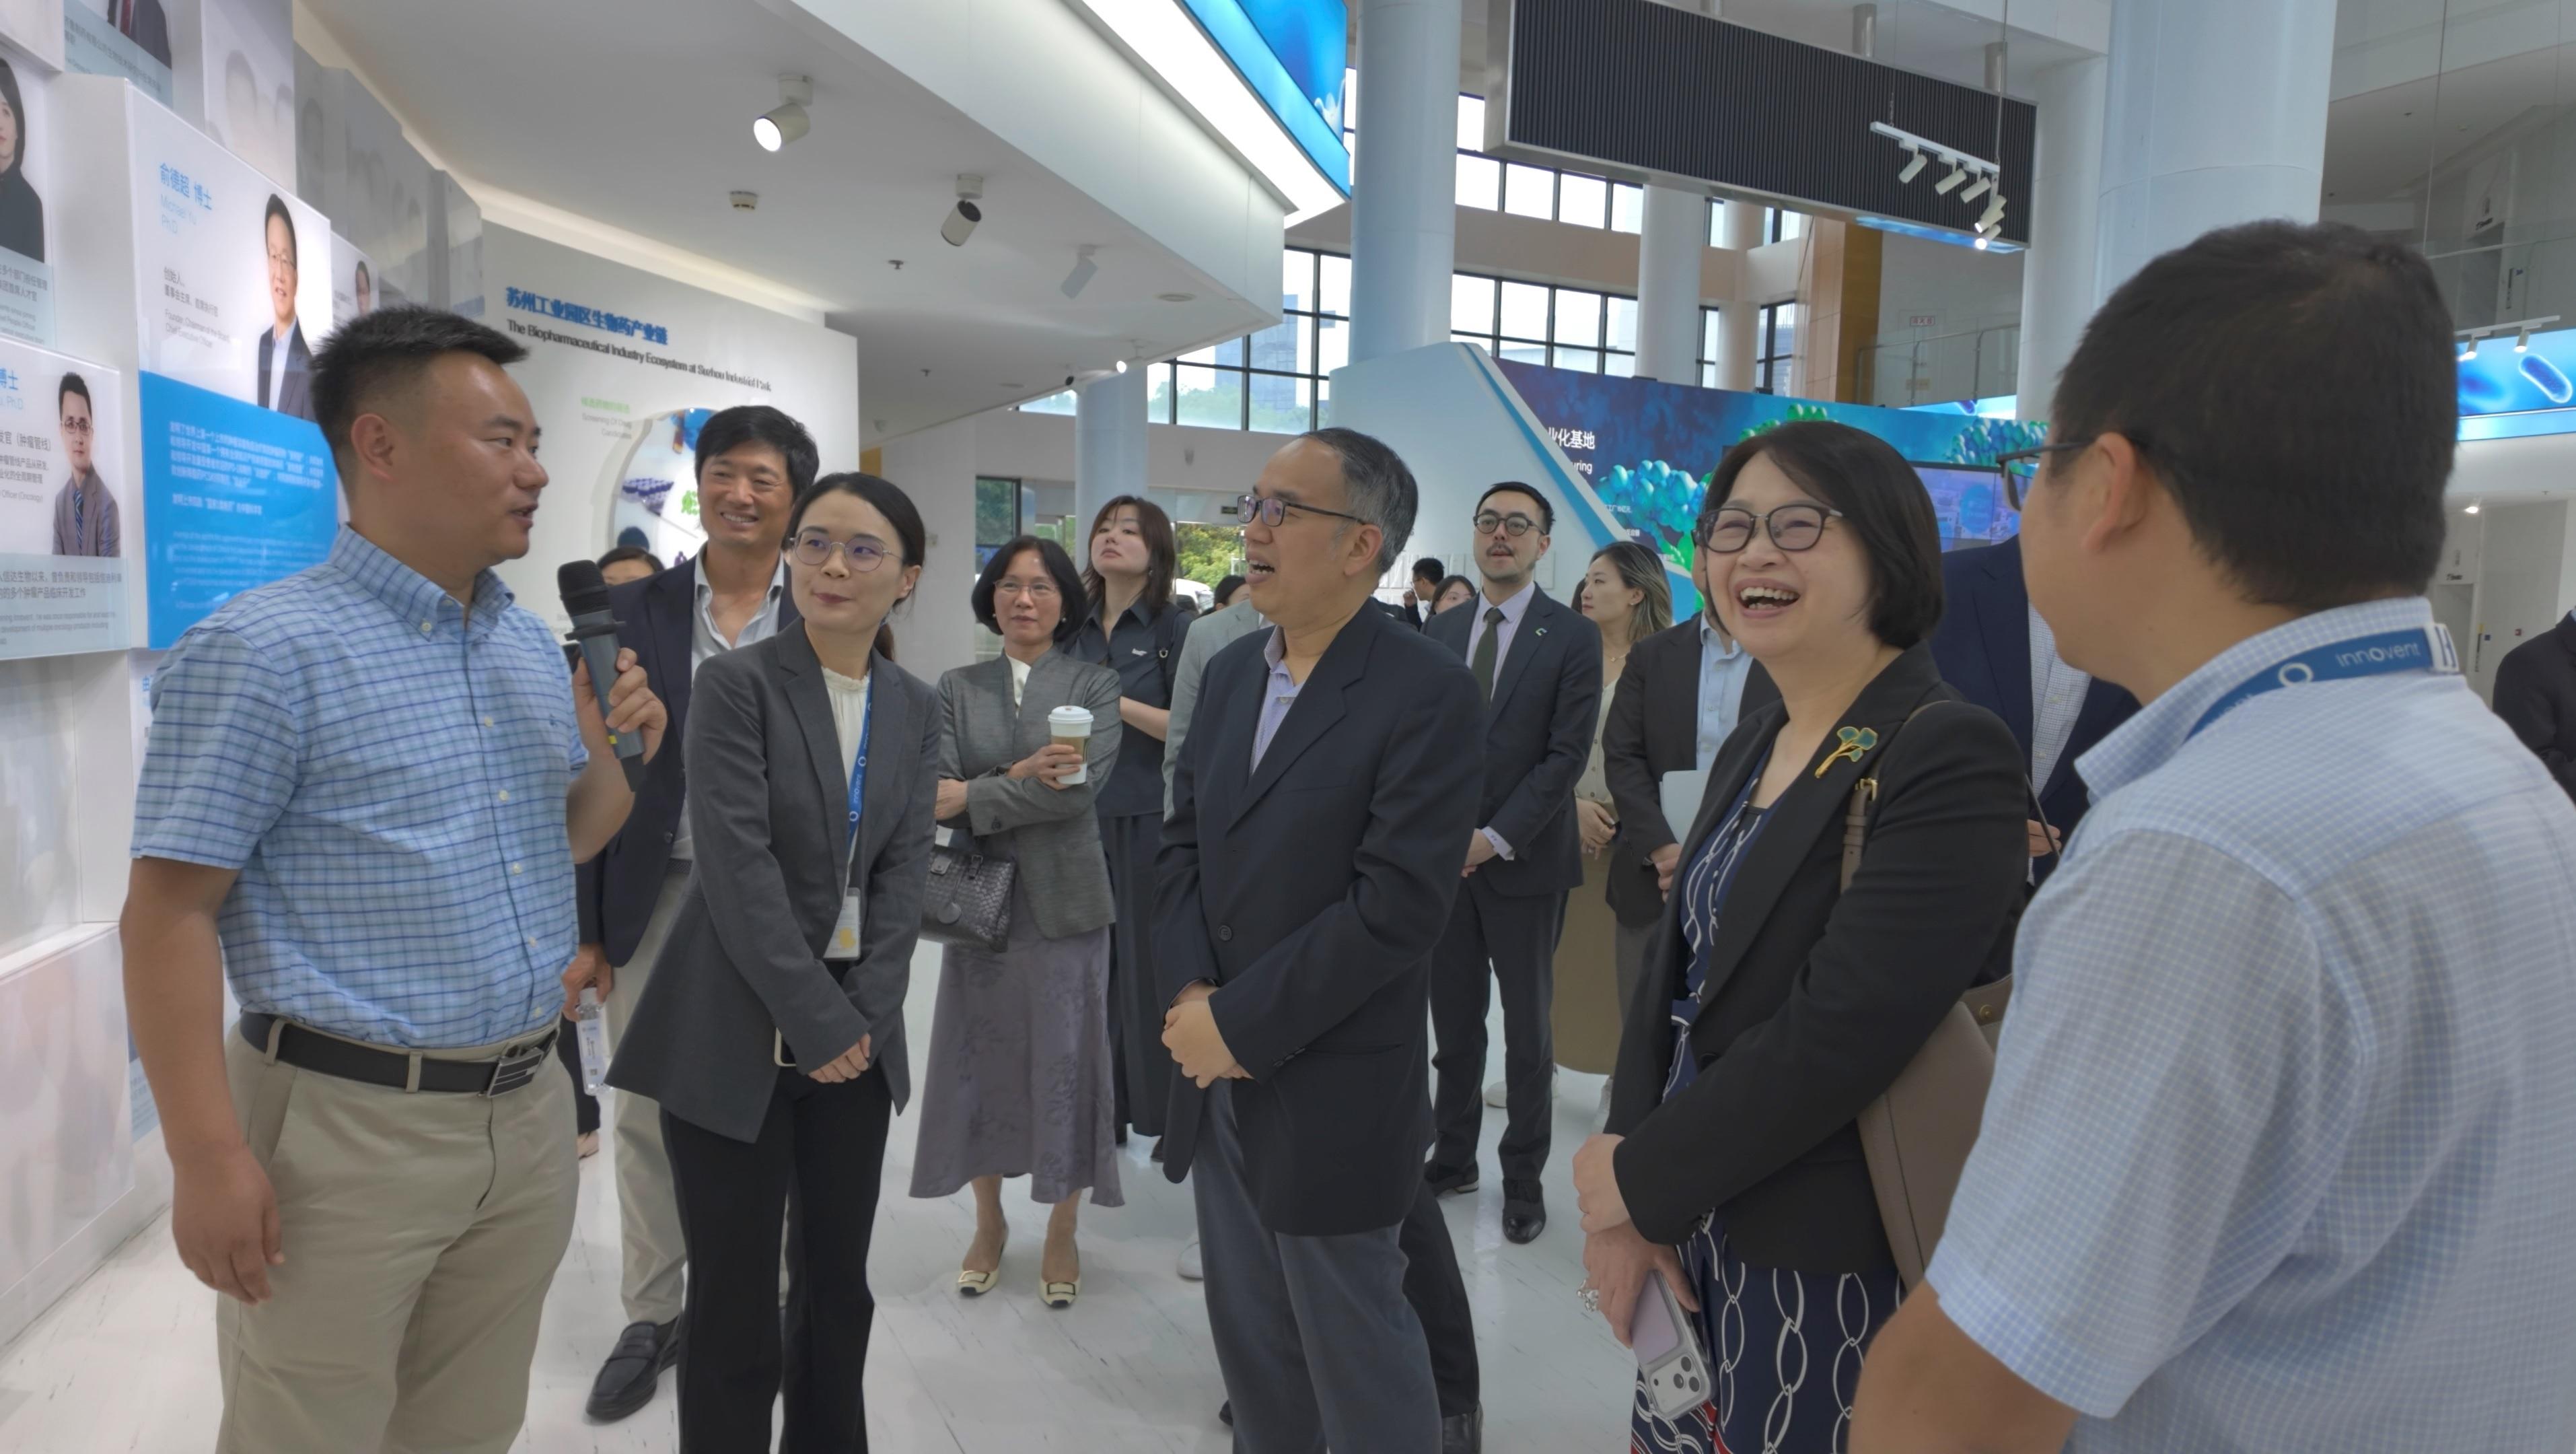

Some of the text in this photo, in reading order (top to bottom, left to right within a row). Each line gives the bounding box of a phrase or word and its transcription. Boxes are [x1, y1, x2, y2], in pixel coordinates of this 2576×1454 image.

[194, 180, 212, 210] 博士
[506, 286, 668, 345] 苏州工业园区生物药产业链
[507, 318, 526, 335] The
[528, 324, 610, 354] Biopharmaceutical
[611, 344, 644, 364] Industry
[646, 352, 687, 372] Ecosystem
[688, 364, 696, 374] at
[698, 364, 725, 381] Suzhou
